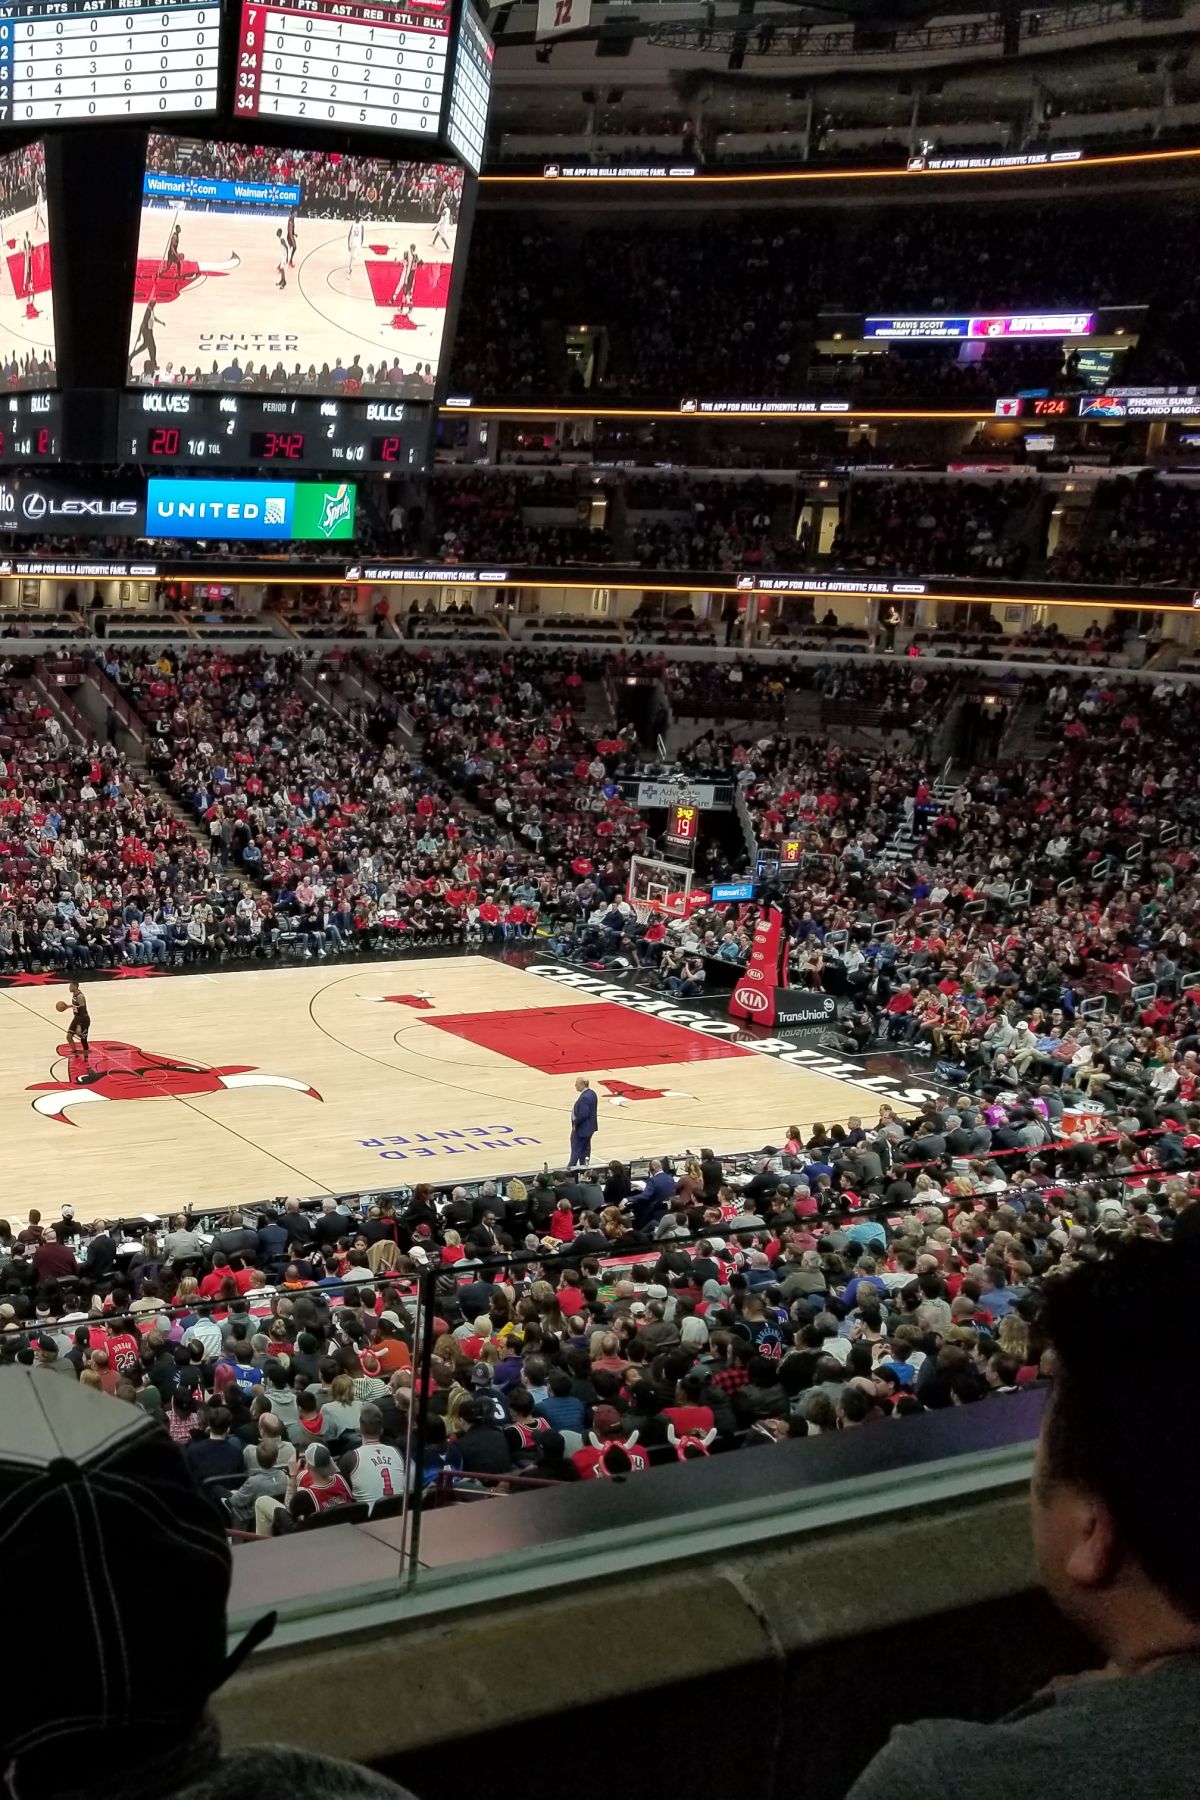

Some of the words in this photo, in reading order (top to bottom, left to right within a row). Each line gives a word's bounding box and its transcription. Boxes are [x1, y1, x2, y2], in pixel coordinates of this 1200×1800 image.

[27, 6, 33, 15] F
[46, 4, 68, 14] PTS
[83, 1, 104, 11] AST
[27, 24, 34, 37] 0
[56, 22, 63, 35] 0
[90, 19, 98, 32] 0
[126, 16, 133, 30] 0
[162, 14, 169, 27] 0
[197, 11, 205, 24] 0
[249, 11, 257, 24] 7
[332, 4, 353, 16] AST
[363, 9, 384, 20] REB
[395, 13, 413, 24] STL
[424, 17, 443, 29] BLK
[28, 44, 33, 56] 1
[56, 42, 63, 55] 3
[90, 40, 97, 52] 0
[128, 38, 132, 50] 1
[161, 35, 168, 48] 0
[197, 32, 204, 45] 0
[246, 32, 255, 46] 8
[26, 65, 34, 78] 0
[56, 64, 62, 76] 6
[90, 61, 97, 74] 3
[124, 58, 132, 71] 0
[160, 56, 168, 69] 0
[196, 54, 204, 66] 0
[240, 53, 257, 68] 24
[28, 84, 32, 97] 1
[54, 83, 62, 95] 4
[91, 81, 96, 93] 1
[124, 78, 131, 91] 6
[160, 76, 167, 89] 0
[195, 74, 203, 86] 0
[239, 73, 255, 88] 32
[26, 105, 33, 118] 0
[55, 103, 62, 116] 7
[88, 102, 96, 114] 0
[125, 99, 130, 112] 1
[159, 97, 166, 110] 0
[194, 95, 202, 108] 0
[238, 94, 253, 109] 34
[148, 179, 185, 193] Walmart
[198, 185, 216, 194] com
[234, 187, 267, 198] Walmart
[279, 192, 296, 200] com
[143, 394, 190, 412] WOLVES
[262, 402, 287, 412] PERIOD
[1034, 401, 1065, 414] 7:24
[1129, 398, 1167, 406] PHOENIX
[1169, 398, 1194, 406] SUNS
[366, 404, 404, 420] BULLS
[227, 420, 235, 434] 2
[327, 424, 335, 438] 2
[152, 430, 179, 454] 20
[208, 444, 220, 454] TOL
[263, 433, 304, 458] 3:42
[382, 438, 399, 461] 12
[332, 448, 343, 458] TOL
[346, 446, 364, 460] 6/0
[49, 500, 138, 516] LEXUS
[157, 501, 259, 519] UNITED
[323, 495, 350, 528] Sprite
[760, 581, 774, 589] THE
[774, 581, 788, 589] APP
[789, 581, 803, 590] FOR
[805, 582, 827, 591] BULLS
[828, 583, 868, 591] AUTHENTIC
[678, 819, 689, 836] 19
[748, 970, 763, 978] KIA
[524, 964, 741, 1034] CHICAGO
[740, 991, 763, 1008] KIA
[778, 1009, 830, 1022] TransUnion
[739, 1037, 941, 1104] BULLS
[354, 1125, 514, 1147] CENTER
[379, 1136, 542, 1160] UNITED
[370, 1457, 392, 1467] ROSE
[380, 1468, 393, 1496] 1
